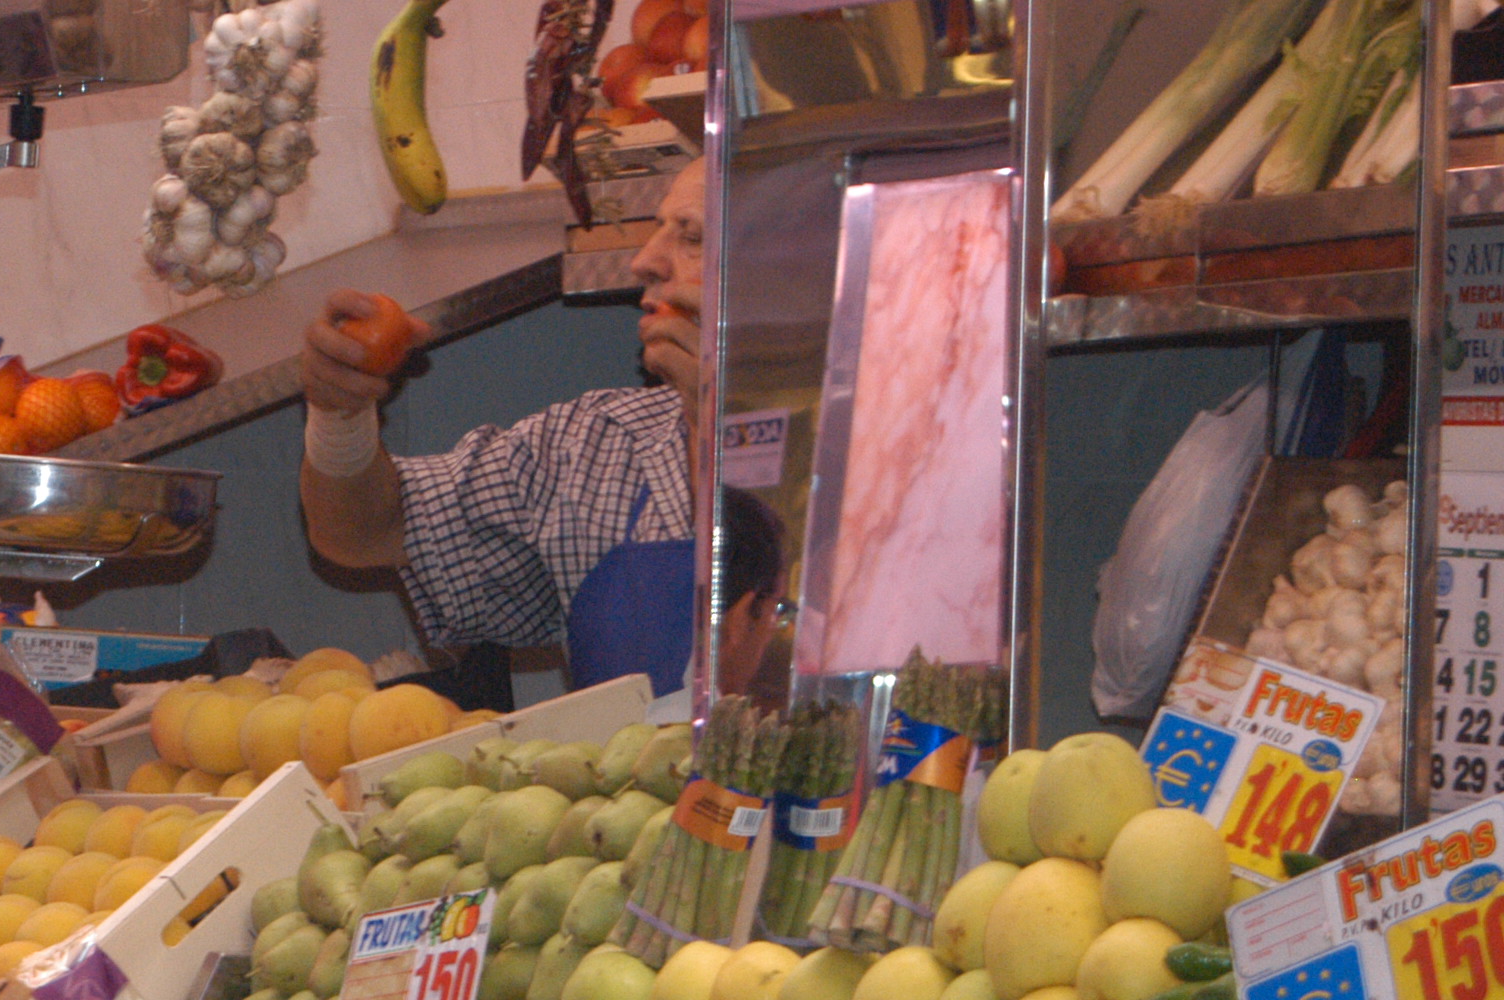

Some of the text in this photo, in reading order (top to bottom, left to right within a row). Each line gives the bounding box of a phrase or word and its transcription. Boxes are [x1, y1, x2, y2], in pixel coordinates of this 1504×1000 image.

[1477, 562, 1491, 599] 1
[13, 635, 95, 651] CLEMENTINA
[1474, 610, 1491, 648] 8
[1436, 657, 1497, 697] 4 15
[1243, 668, 1363, 743] Frutas
[1260, 724, 1294, 746] KILO
[1455, 707, 1493, 745] 22
[1431, 753, 1446, 790] 8
[1453, 755, 1488, 794] 29
[1335, 819, 1497, 924] Frutas
[1379, 893, 1424, 924] KILO
[357, 909, 431, 953] FRUTAS
